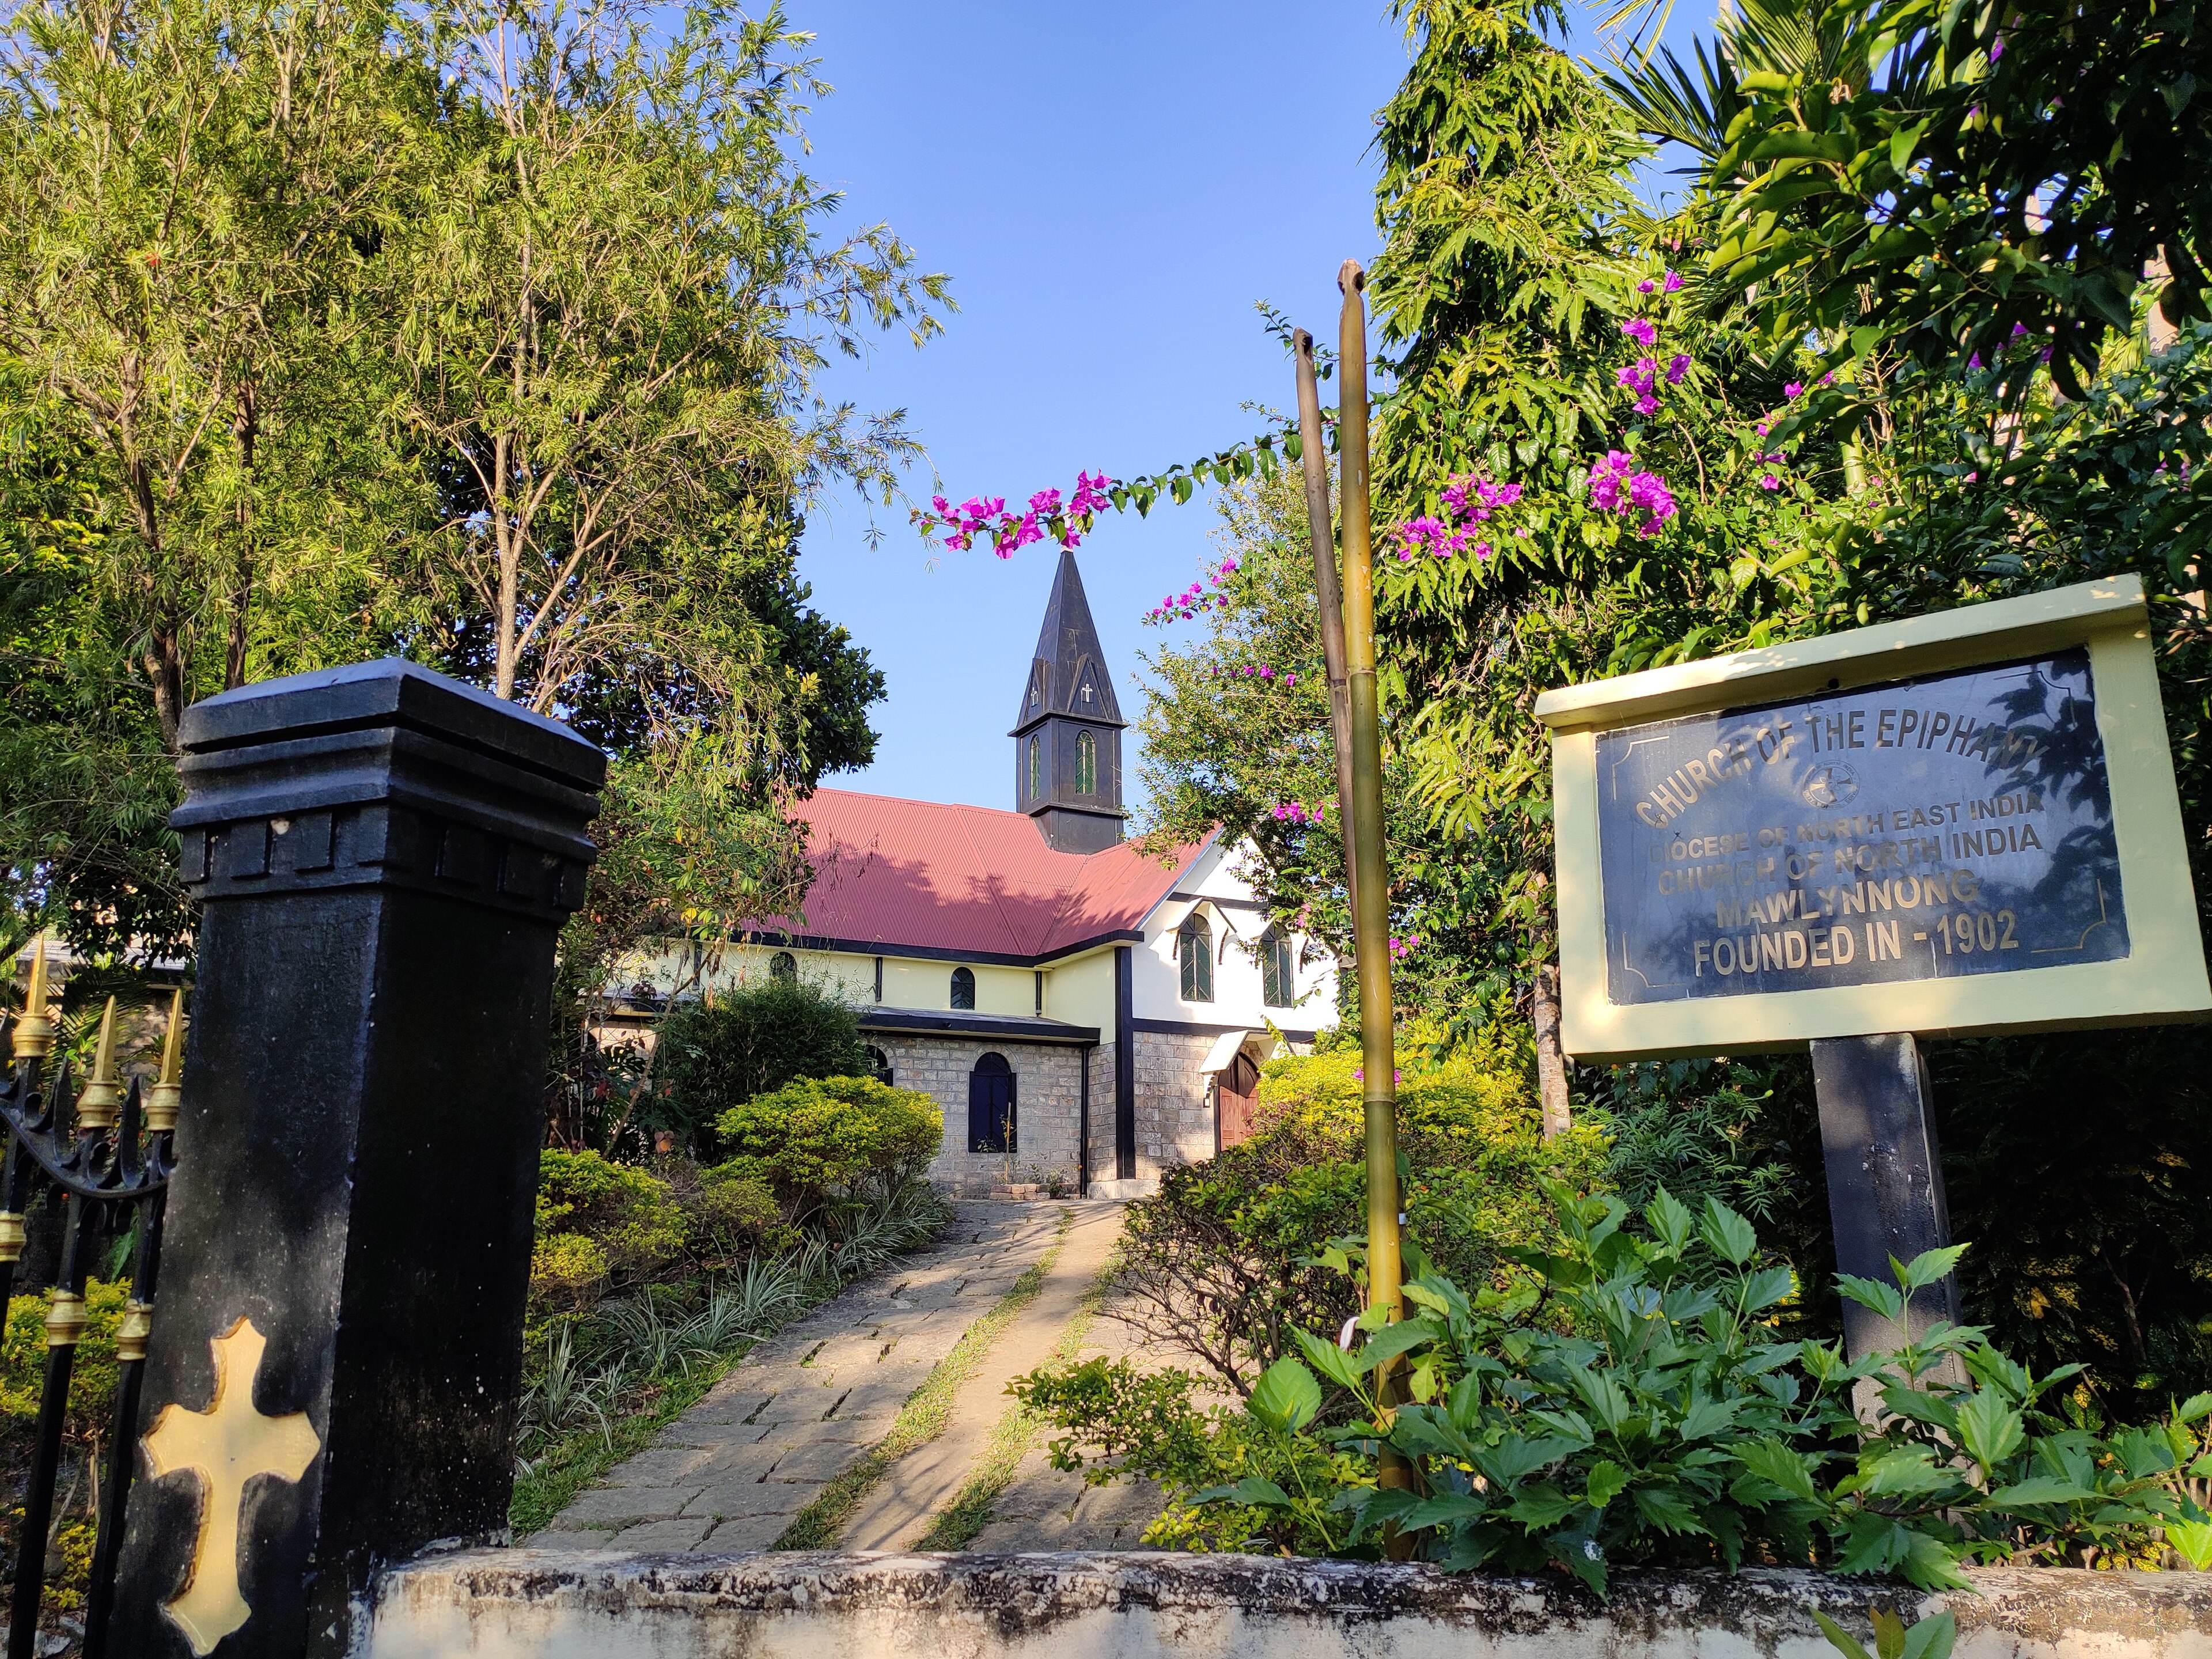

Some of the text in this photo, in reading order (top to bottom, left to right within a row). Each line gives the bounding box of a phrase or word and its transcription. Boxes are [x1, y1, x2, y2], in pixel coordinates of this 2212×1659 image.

[1636, 738, 1752, 829] CHURCH
[1756, 721, 1796, 765] OF
[1805, 710, 1865, 753] THE
[1877, 709, 2050, 777] EPIPHANY
[1649, 792, 2046, 862] DIOCESE OF NORTH EAST INDIA
[1658, 823, 2043, 895] CHURCH OF NORTH INDIA
[1716, 869, 1980, 928] MAWLYNNONG
[1694, 926, 1855, 978] FOUNDED
[1865, 919, 1902, 962] IN
[1937, 909, 2020, 955] 1902
